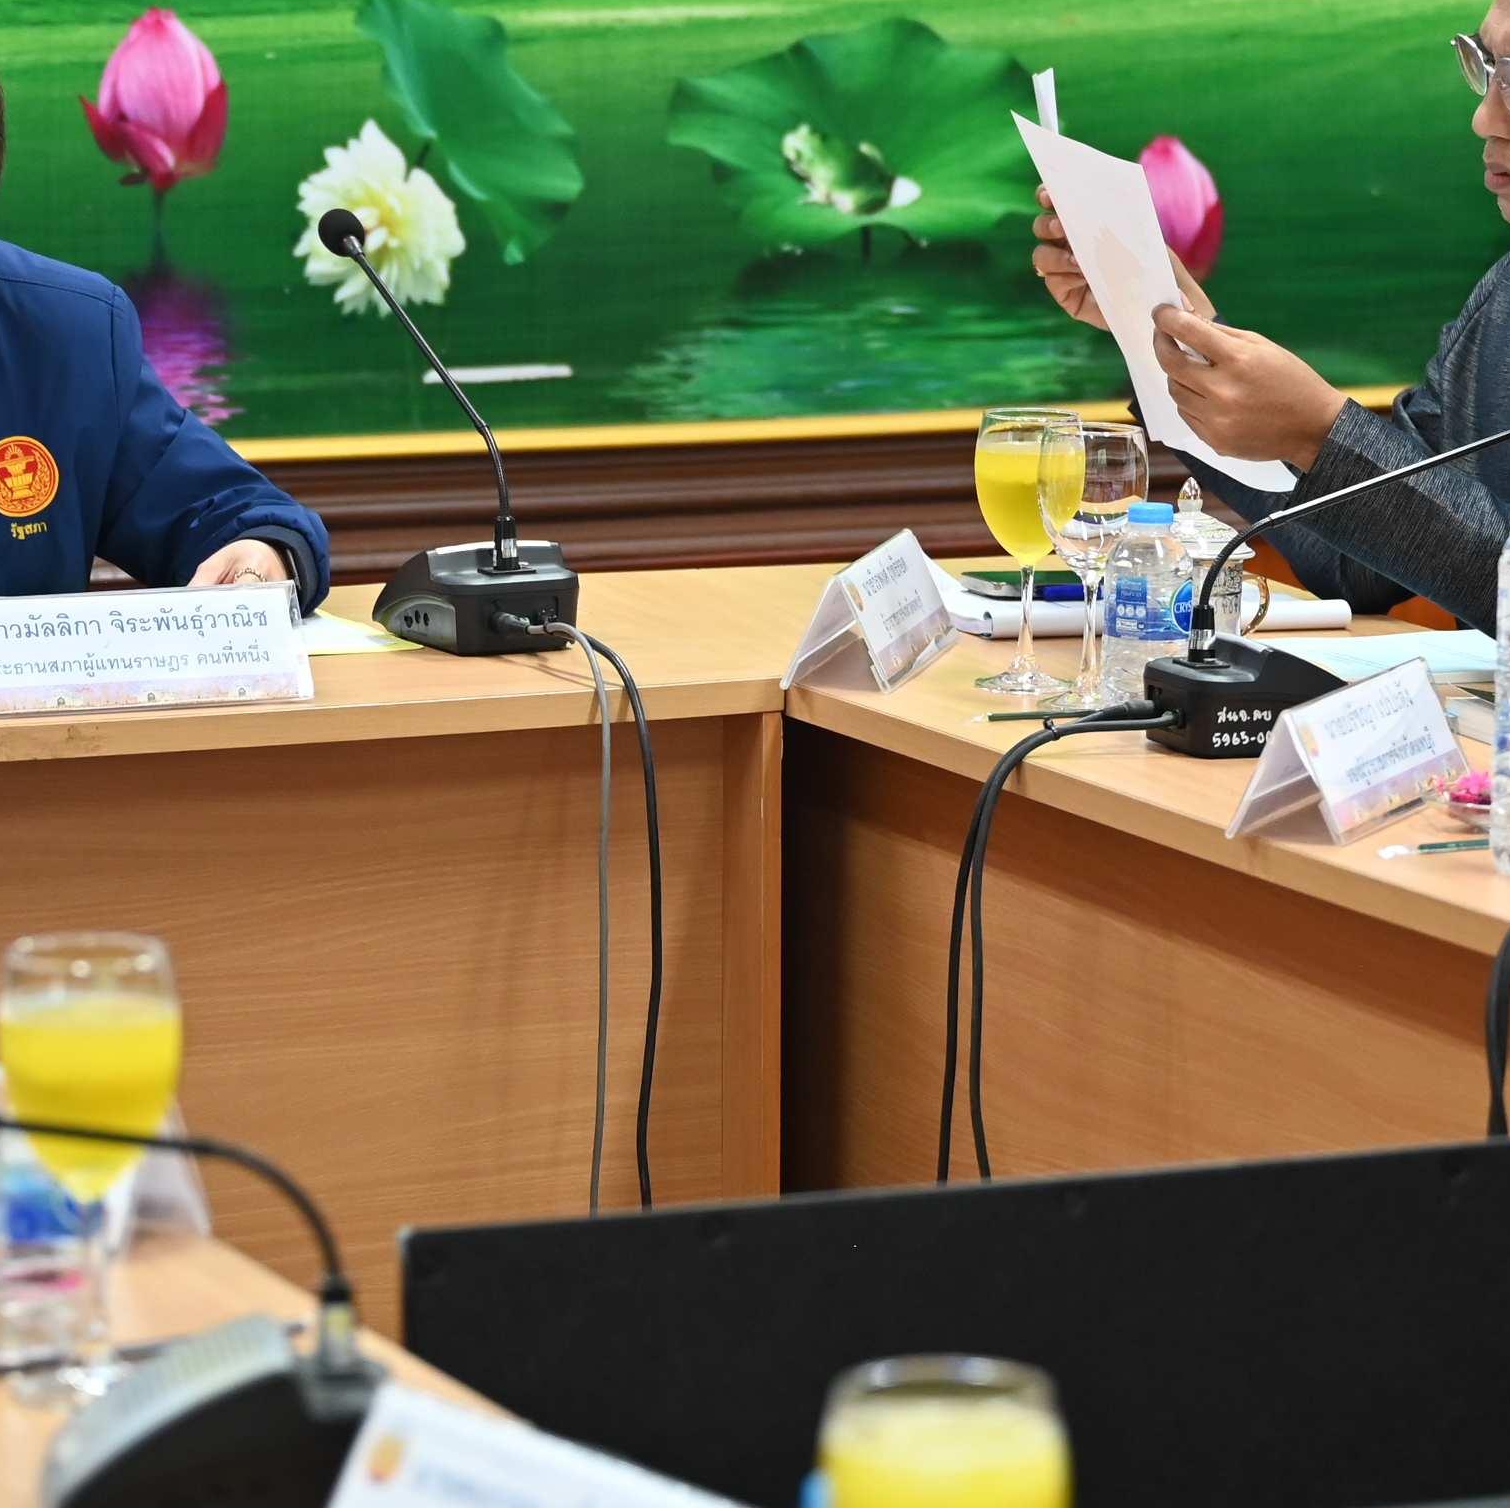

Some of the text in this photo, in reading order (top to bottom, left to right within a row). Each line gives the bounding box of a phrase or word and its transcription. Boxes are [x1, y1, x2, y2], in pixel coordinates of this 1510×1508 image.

[9, 521, 48, 540] รัฐสภา
[109, 603, 269, 638] จิระพันธุ์วาณิช
[196, 639, 271, 666] คนที่หนึ่ง
